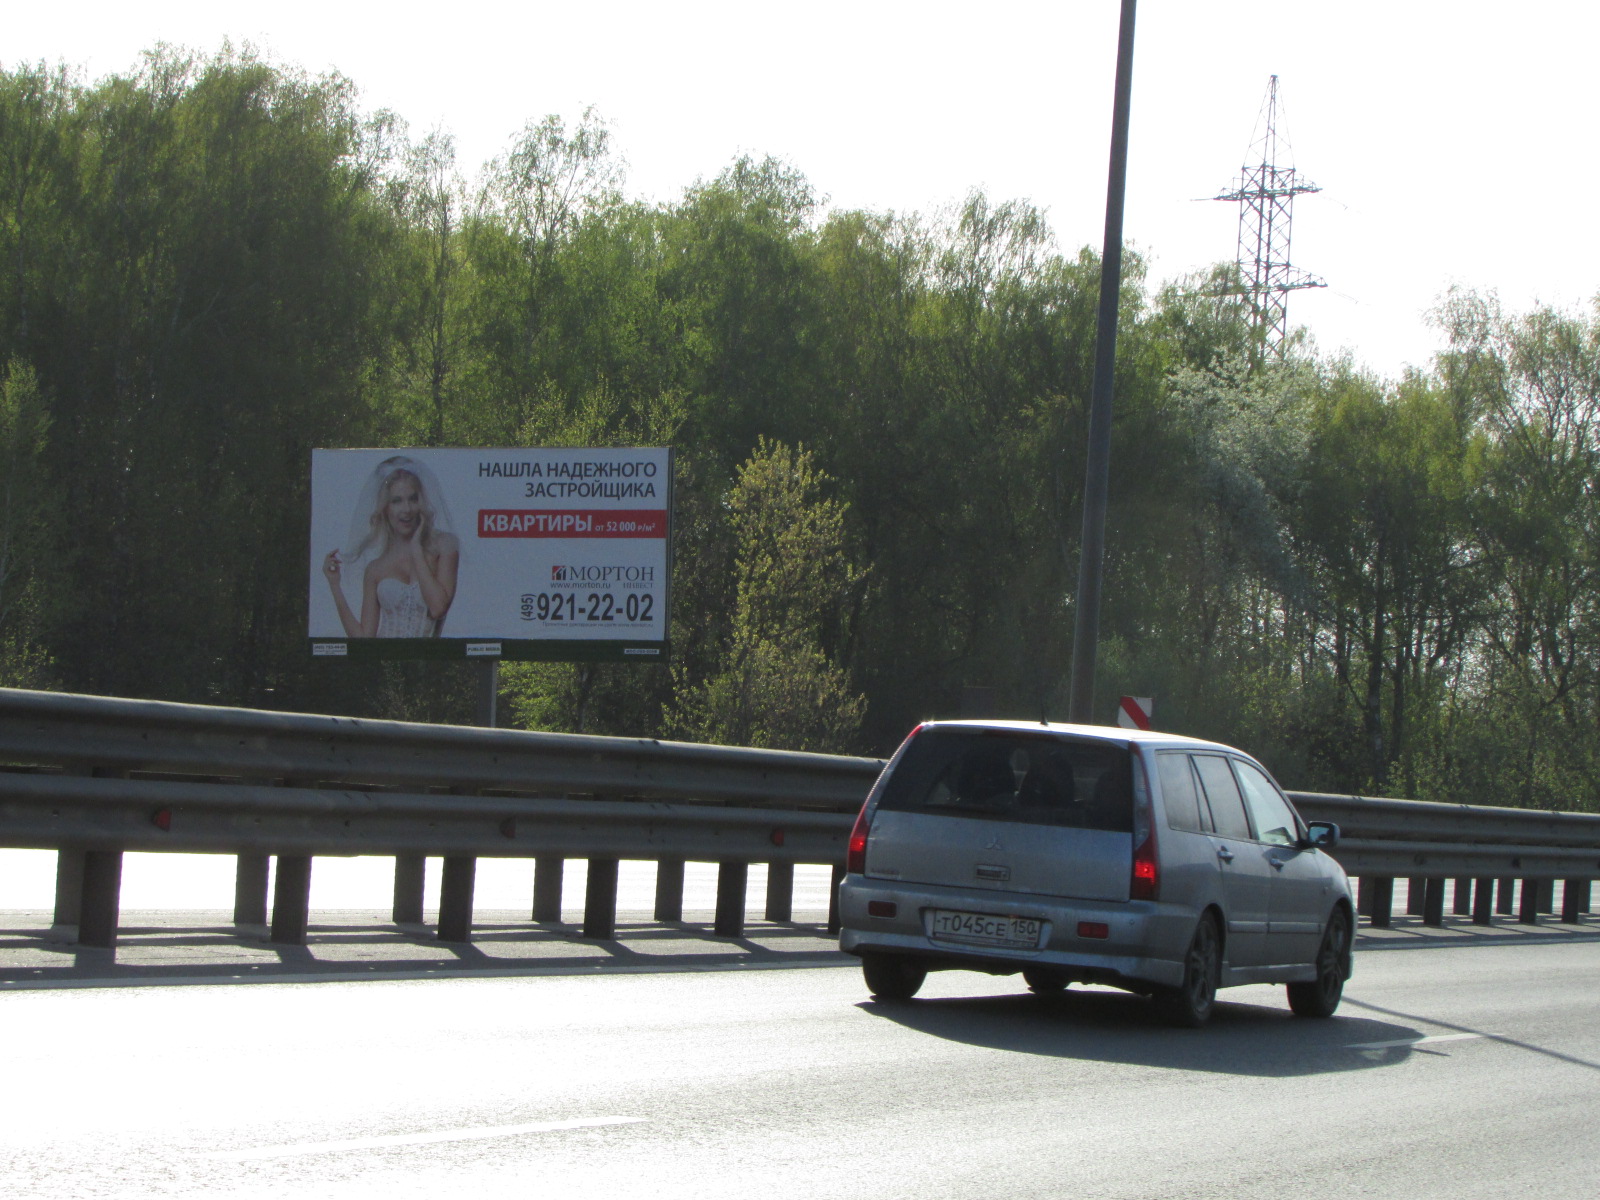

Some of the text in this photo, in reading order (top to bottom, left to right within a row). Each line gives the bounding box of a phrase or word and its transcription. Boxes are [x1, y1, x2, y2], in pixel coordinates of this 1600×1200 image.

[478, 462, 657, 480] НАШЛА НАДЕЖНОГО
[525, 480, 656, 500] ЗАСТРОЙЩИКА
[483, 514, 593, 532] КВАРТИРЫ
[606, 521, 617, 532] 52
[619, 521, 636, 532] 000
[569, 566, 654, 581] МОРТОН
[550, 581, 611, 590] www.morton.ru
[520, 593, 537, 621] (495)
[537, 592, 654, 622] 921-22-02
[1010, 920, 1036, 936] 150
